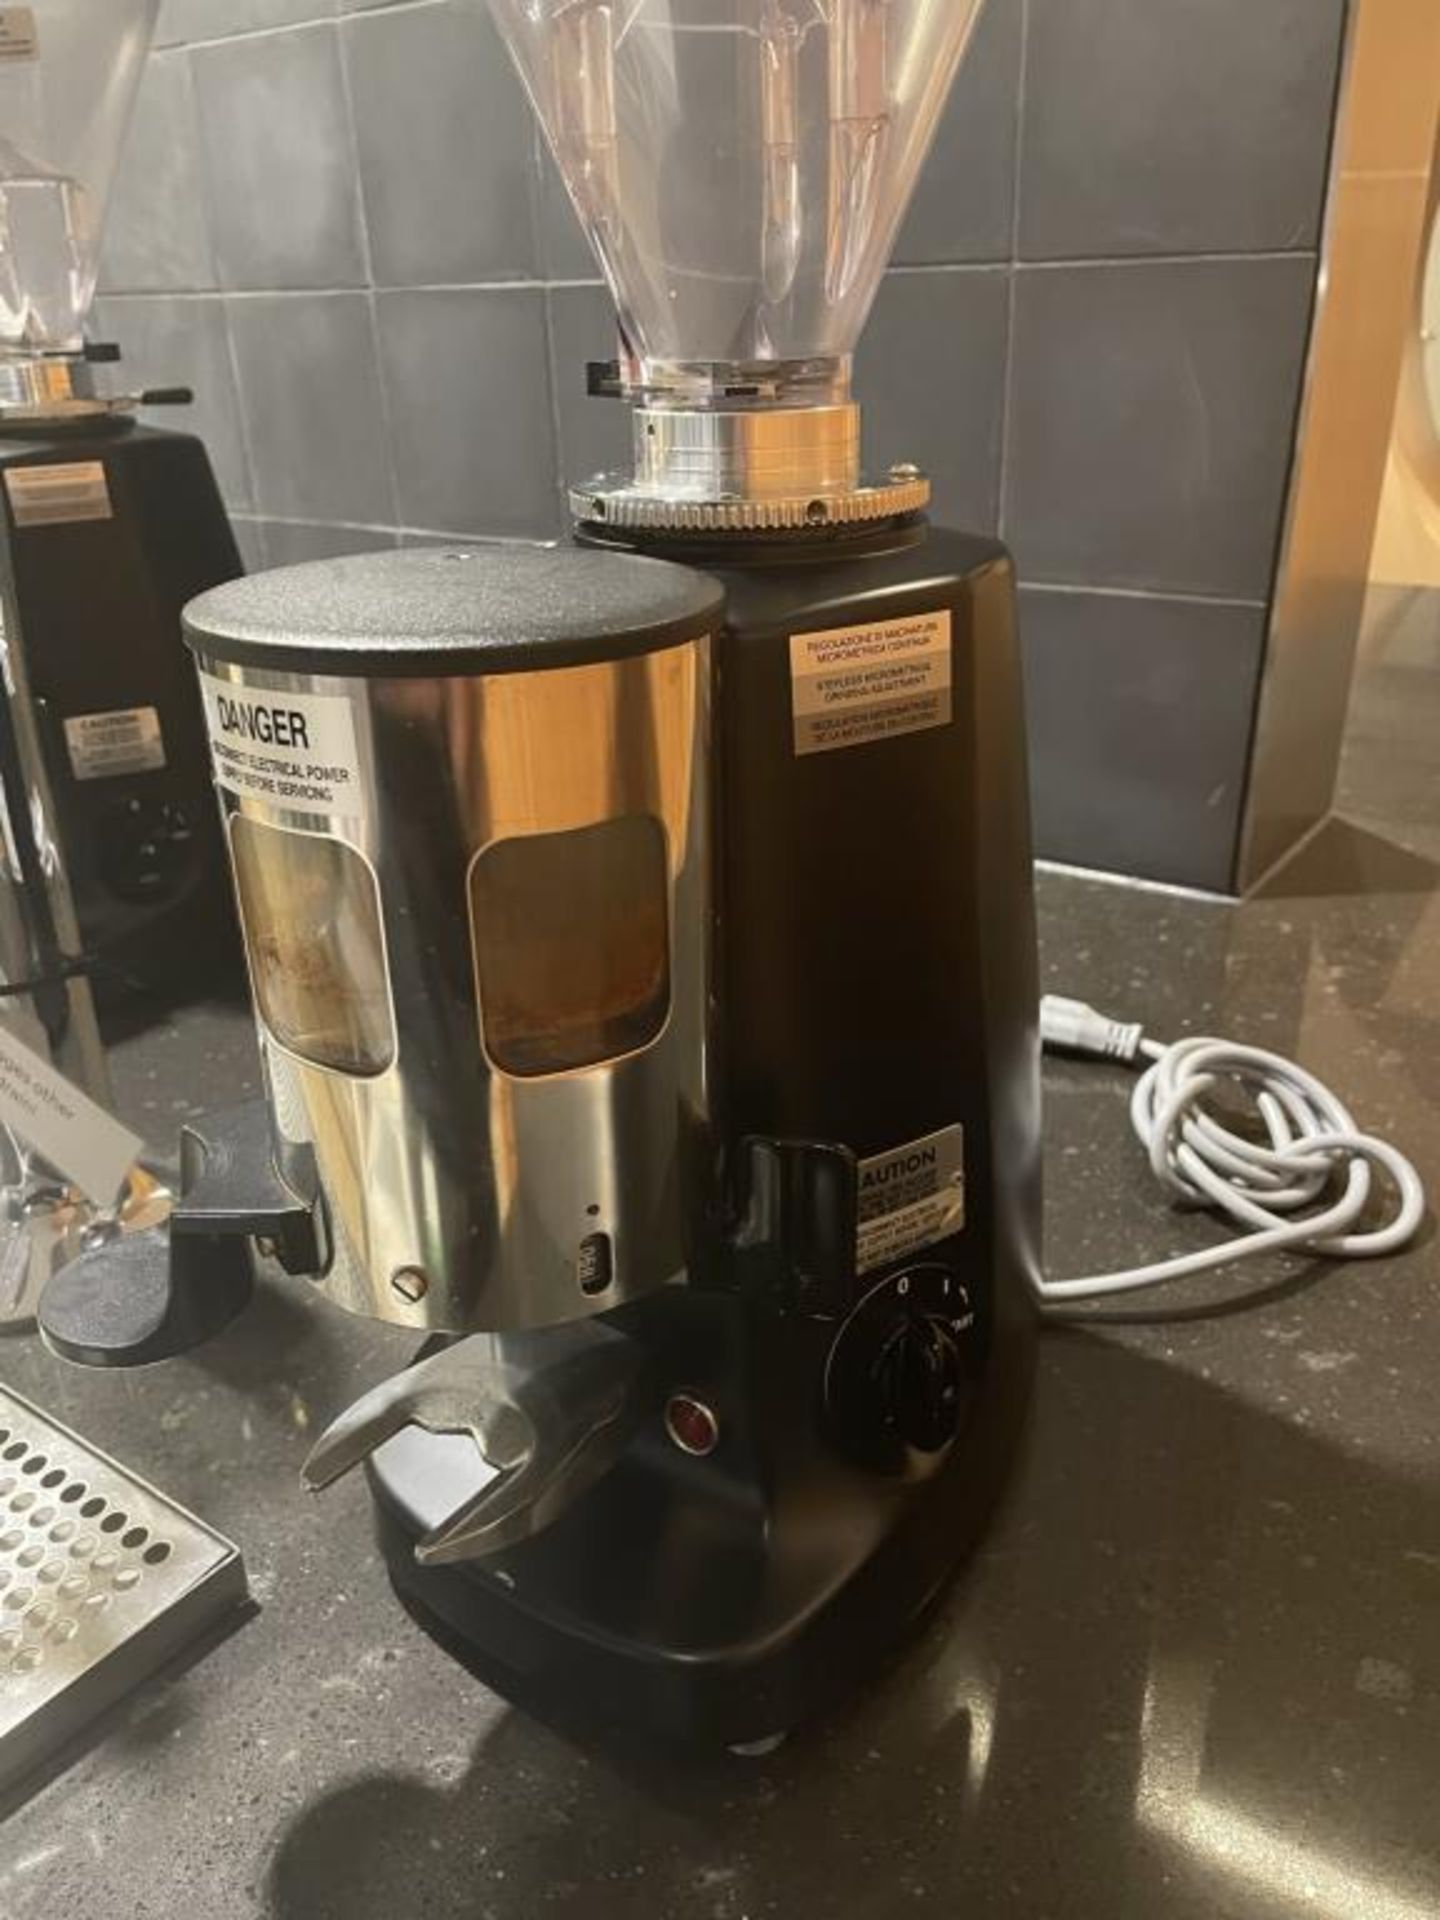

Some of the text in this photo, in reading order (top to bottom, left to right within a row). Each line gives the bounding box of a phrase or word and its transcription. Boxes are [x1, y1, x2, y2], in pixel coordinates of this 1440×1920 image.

[217, 694, 309, 749] DANGER
[306, 765, 350, 784] POWER
[863, 1147, 936, 1188] AUTION
